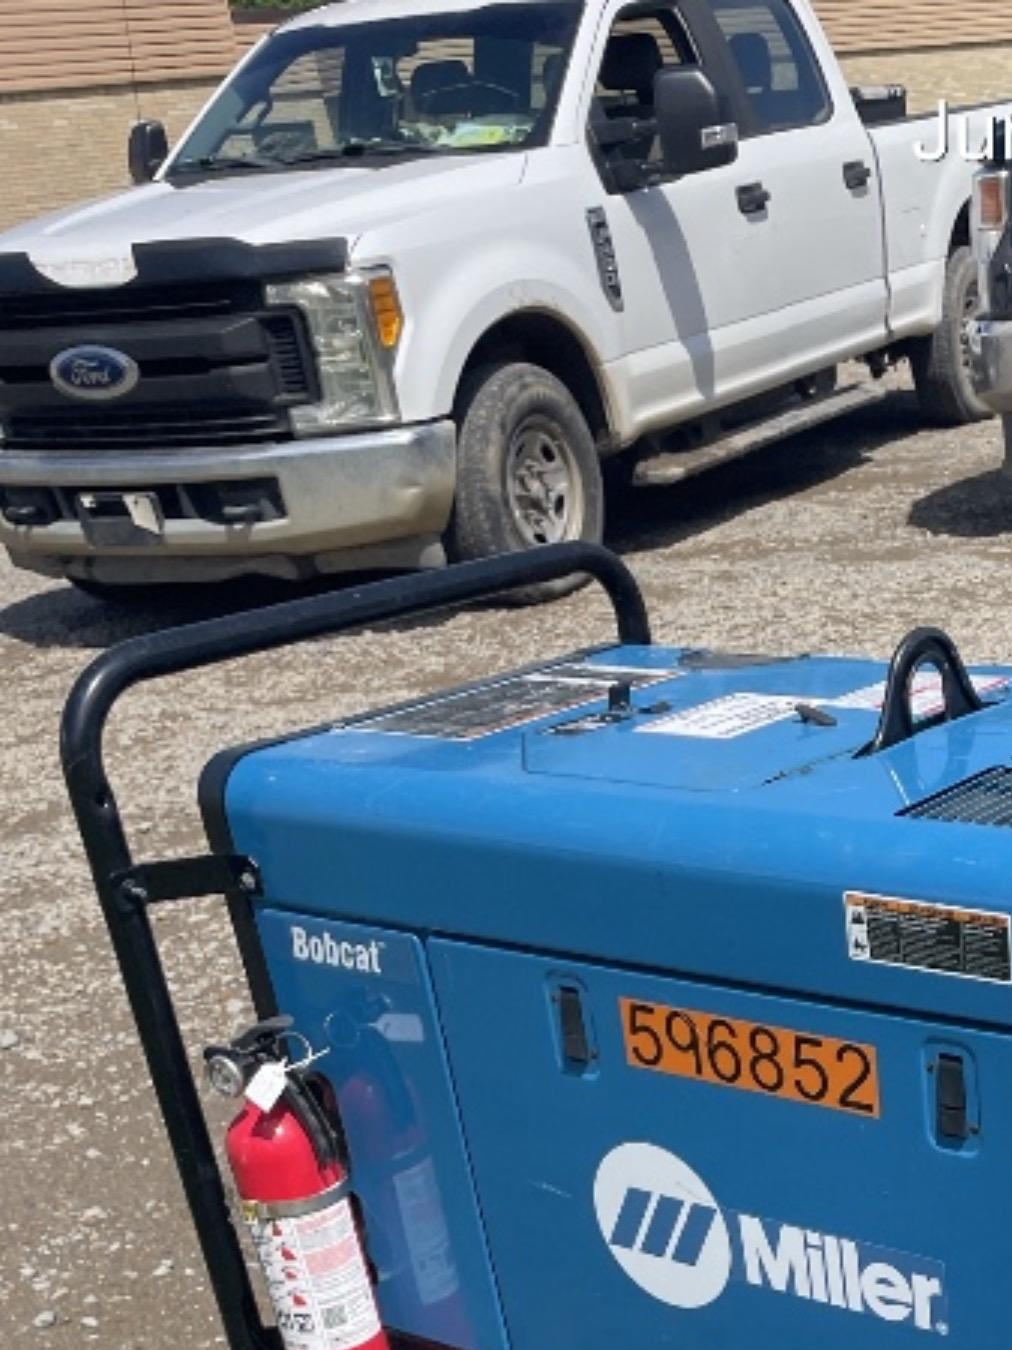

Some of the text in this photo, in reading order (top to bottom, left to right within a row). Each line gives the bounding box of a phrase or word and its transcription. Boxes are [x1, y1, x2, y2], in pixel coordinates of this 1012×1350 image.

[72, 359, 112, 385] Ford
[290, 925, 383, 976] Bobcat
[629, 1003, 875, 1115] 596852
